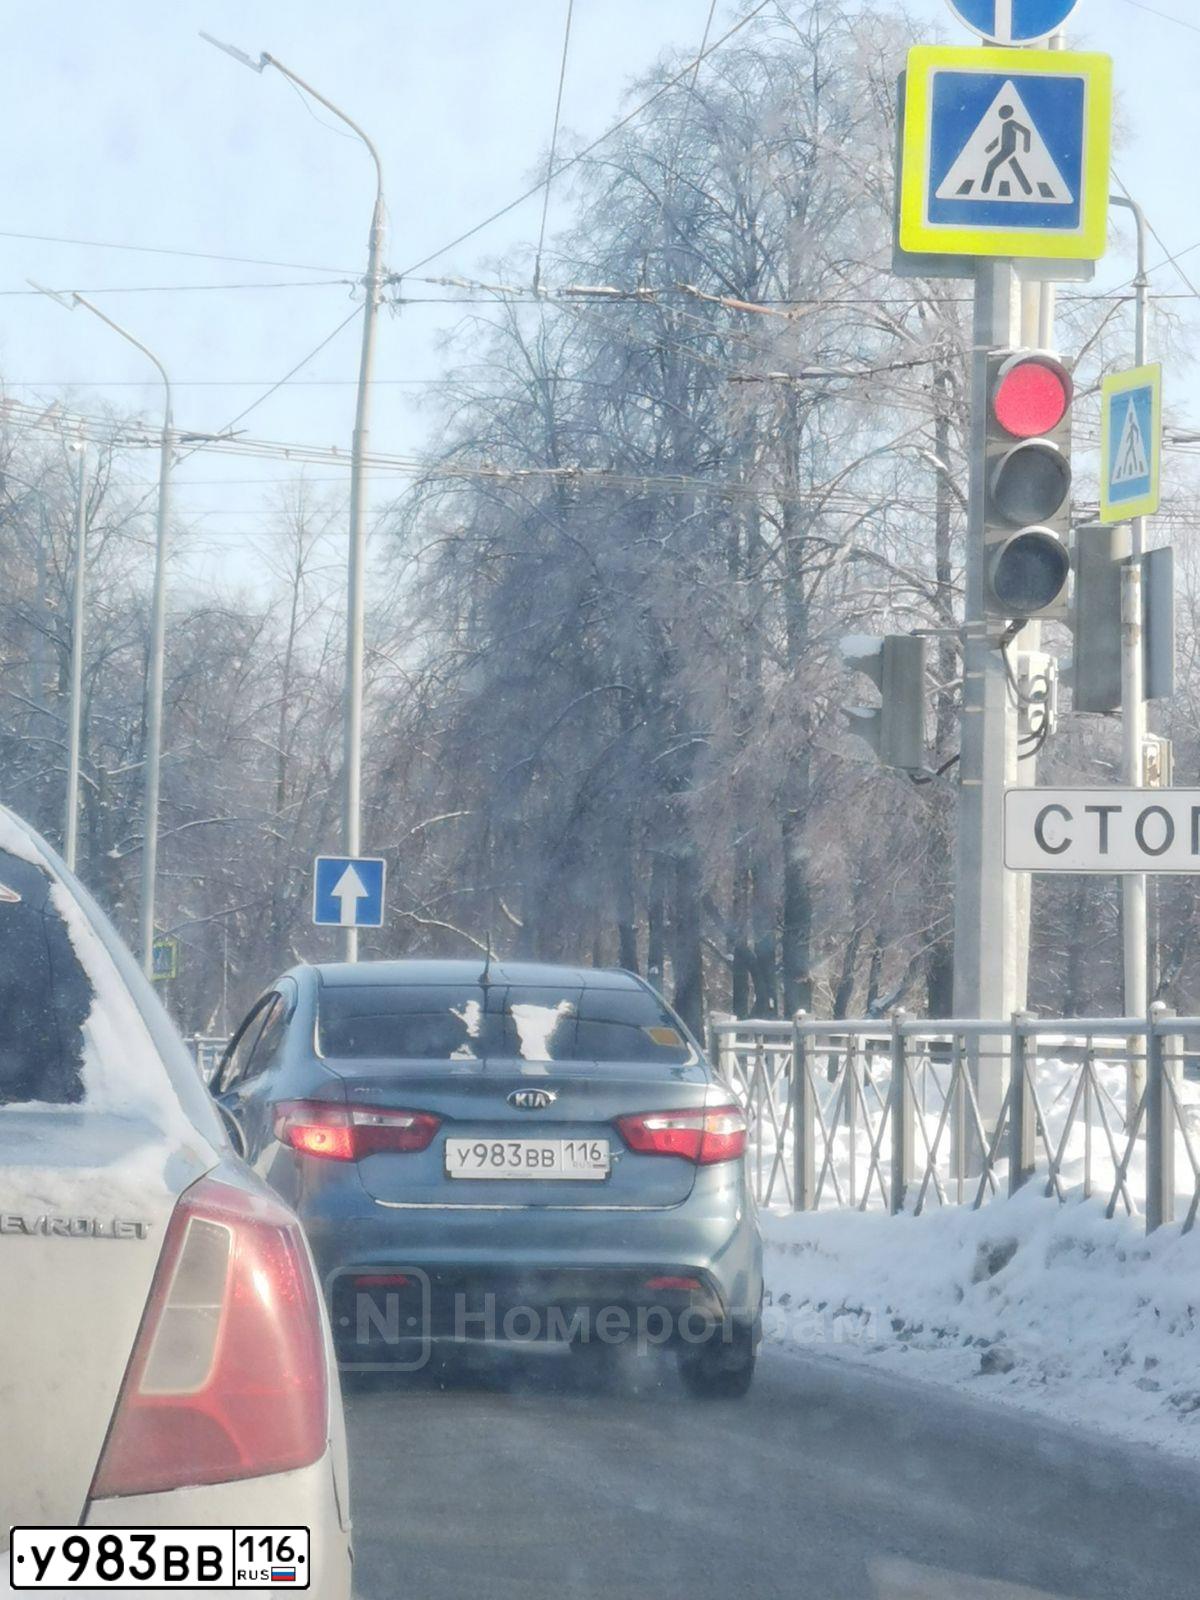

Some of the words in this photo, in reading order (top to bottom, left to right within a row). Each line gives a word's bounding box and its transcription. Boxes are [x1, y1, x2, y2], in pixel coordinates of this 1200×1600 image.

[1034, 804, 1200, 856] СТО
[515, 1093, 547, 1108] KIA
[457, 1143, 555, 1168] У983ВВ
[564, 1142, 601, 1161] 116
[0, 1213, 151, 1240] EVROLET
